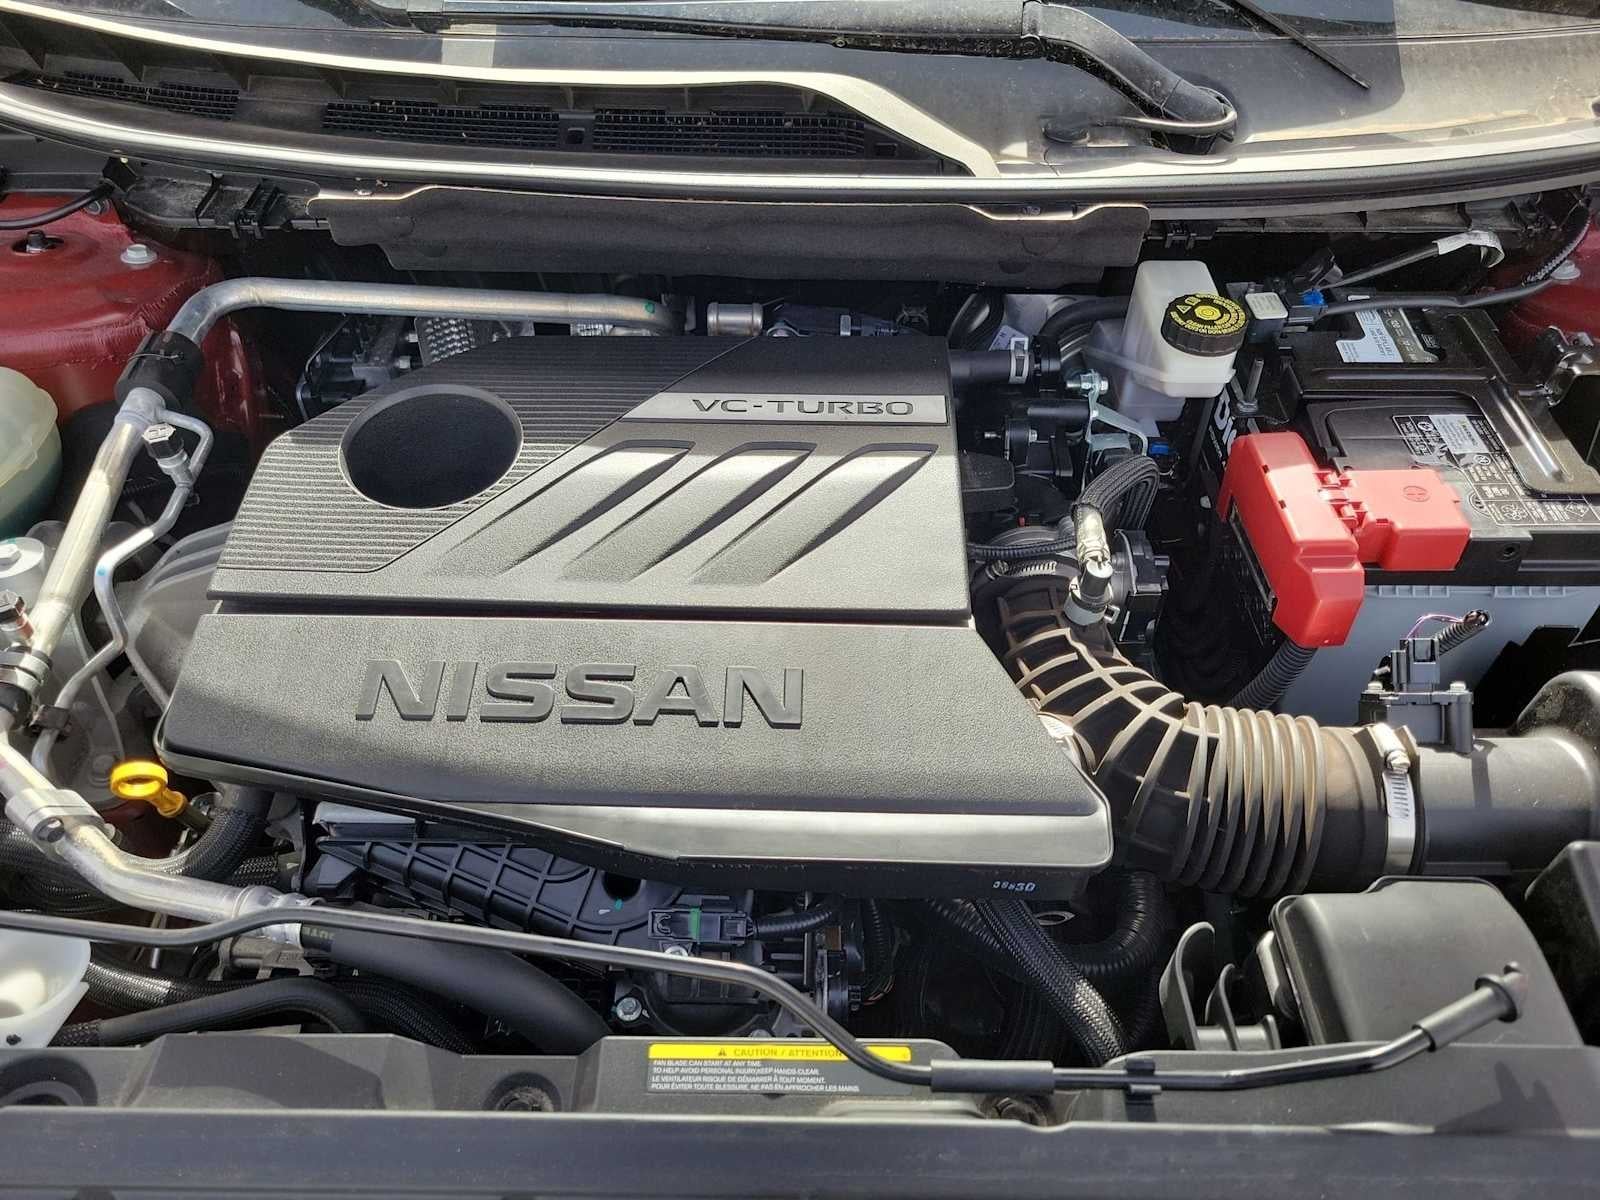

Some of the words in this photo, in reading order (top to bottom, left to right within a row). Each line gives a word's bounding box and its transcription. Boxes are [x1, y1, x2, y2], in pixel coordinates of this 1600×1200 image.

[692, 398, 914, 415] VC-TURBO
[355, 659, 804, 729] NISSAN
[734, 1048, 778, 1057] CAUTION
